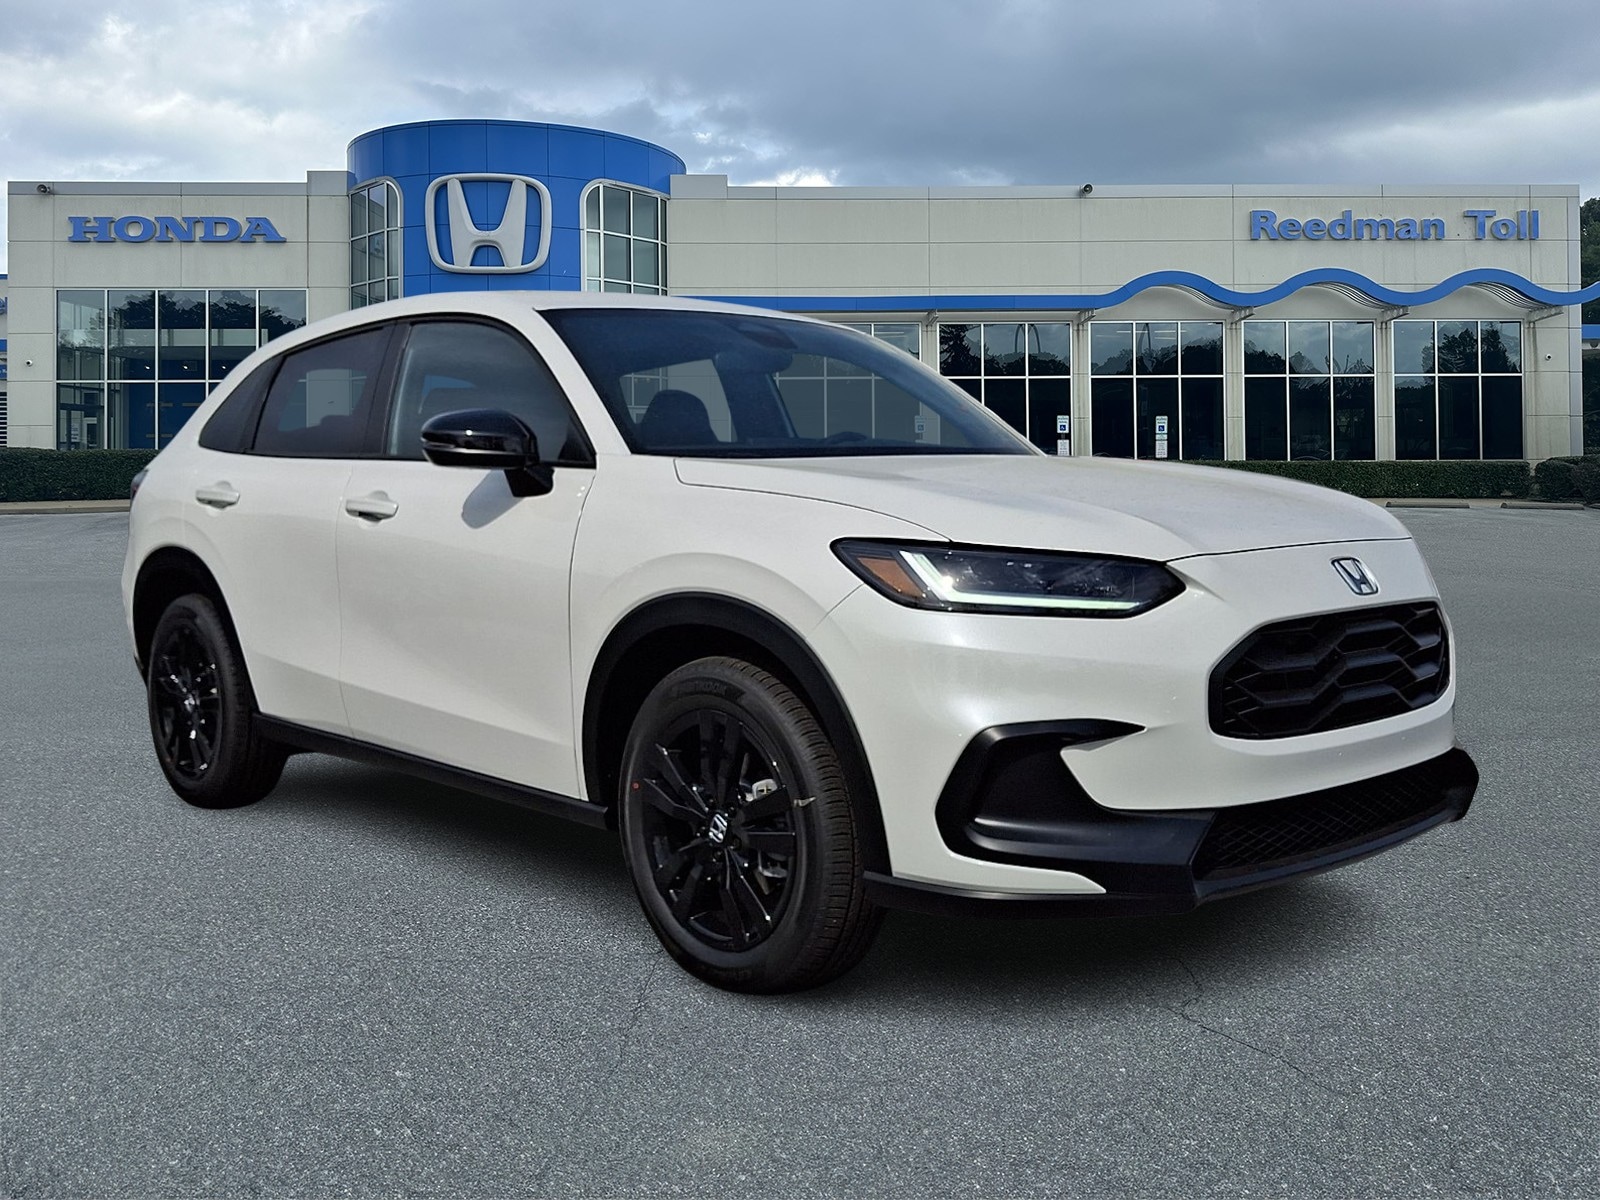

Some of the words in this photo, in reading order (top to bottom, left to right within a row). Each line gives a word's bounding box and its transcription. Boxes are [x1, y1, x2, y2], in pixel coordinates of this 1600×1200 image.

[68, 215, 287, 243] HONDA
[1249, 209, 1446, 241] Reedman
[1463, 209, 1540, 241] Toll
